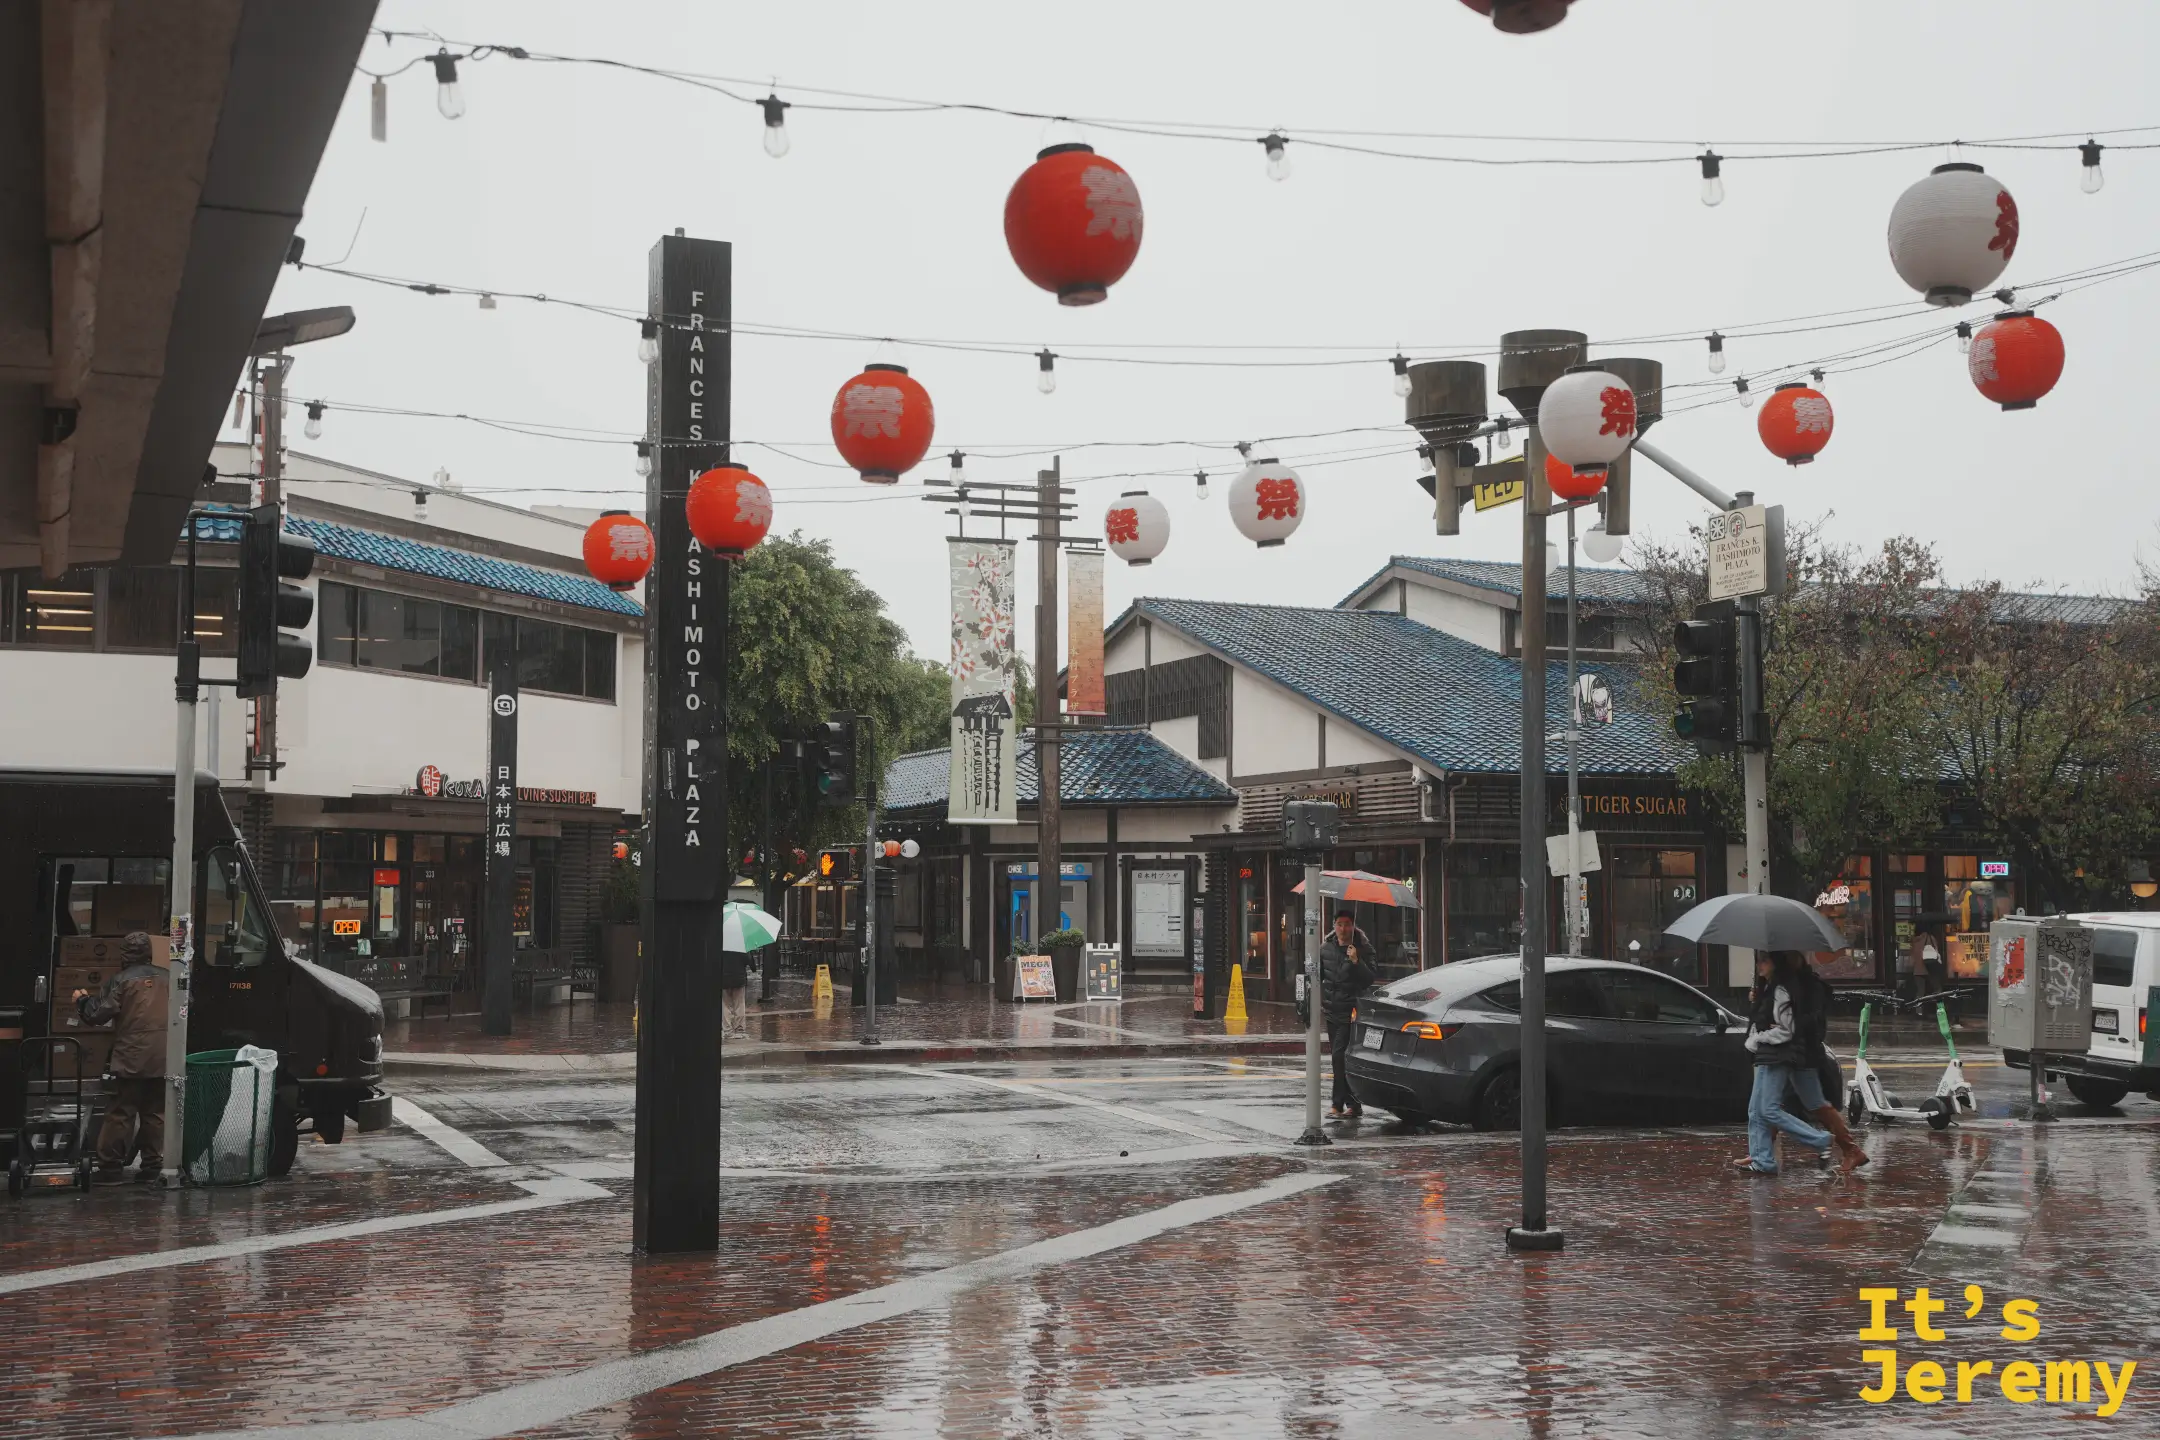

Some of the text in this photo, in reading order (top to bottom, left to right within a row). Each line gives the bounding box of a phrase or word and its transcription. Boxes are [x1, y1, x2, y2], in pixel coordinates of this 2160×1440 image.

[689, 291, 704, 441] FRANCES
[1717, 538, 1750, 553] FRANCES
[1716, 546, 1761, 563] HASHIMOTO
[1725, 560, 1749, 571] PLAZA
[685, 526, 703, 711] ASHIMOTO
[549, 790, 577, 804] SUSHI
[580, 792, 597, 805] BAR
[685, 739, 701, 846] PLAZA
[494, 766, 512, 857] 日本村広場
[1583, 795, 1687, 815] TIGER SUGAR
[1137, 872, 1179, 880] 日本村プラザ
[1983, 863, 2007, 874] OPEN
[335, 921, 359, 933] OPEN
[1973, 934, 1990, 943] VINTA
